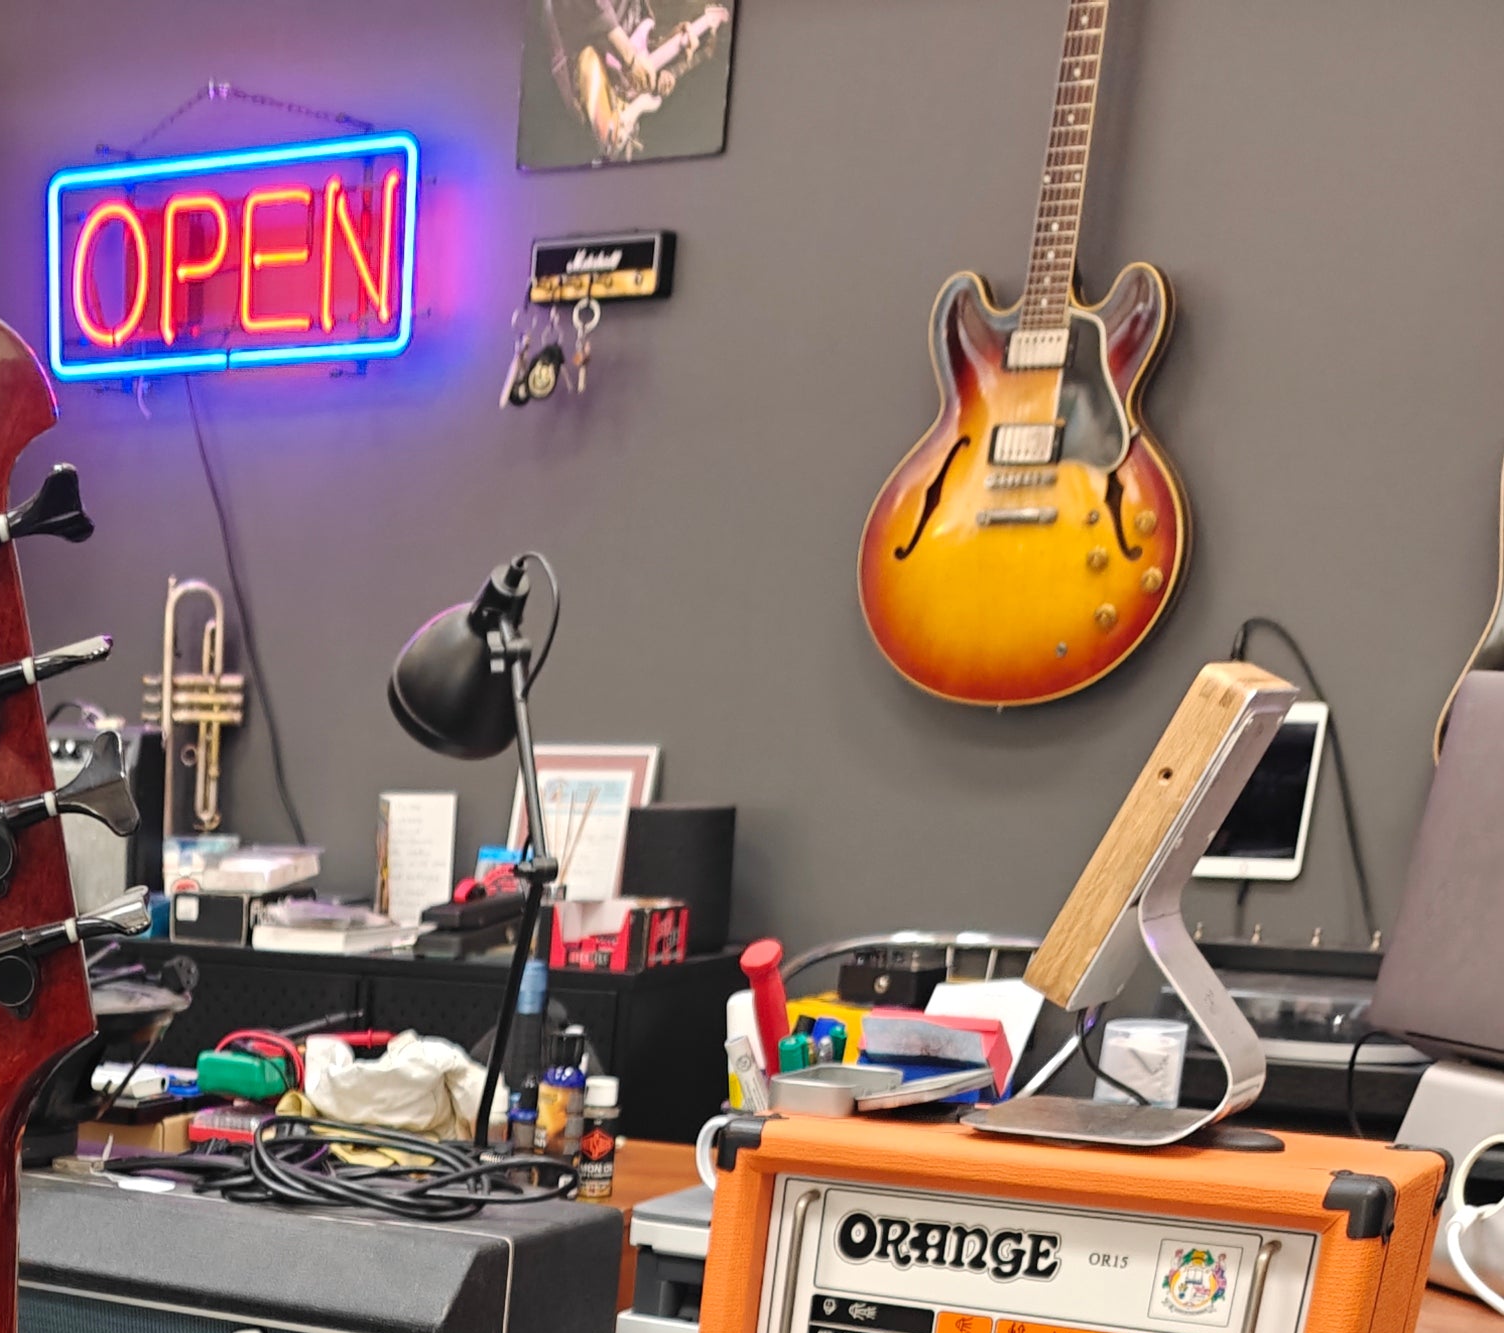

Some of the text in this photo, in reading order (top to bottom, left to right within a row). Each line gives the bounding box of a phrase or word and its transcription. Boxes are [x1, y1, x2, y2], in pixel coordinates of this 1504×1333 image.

[72, 167, 400, 348] OPEN
[837, 1211, 1062, 1283] ORANGE
[1088, 1251, 1129, 1269] OR15
